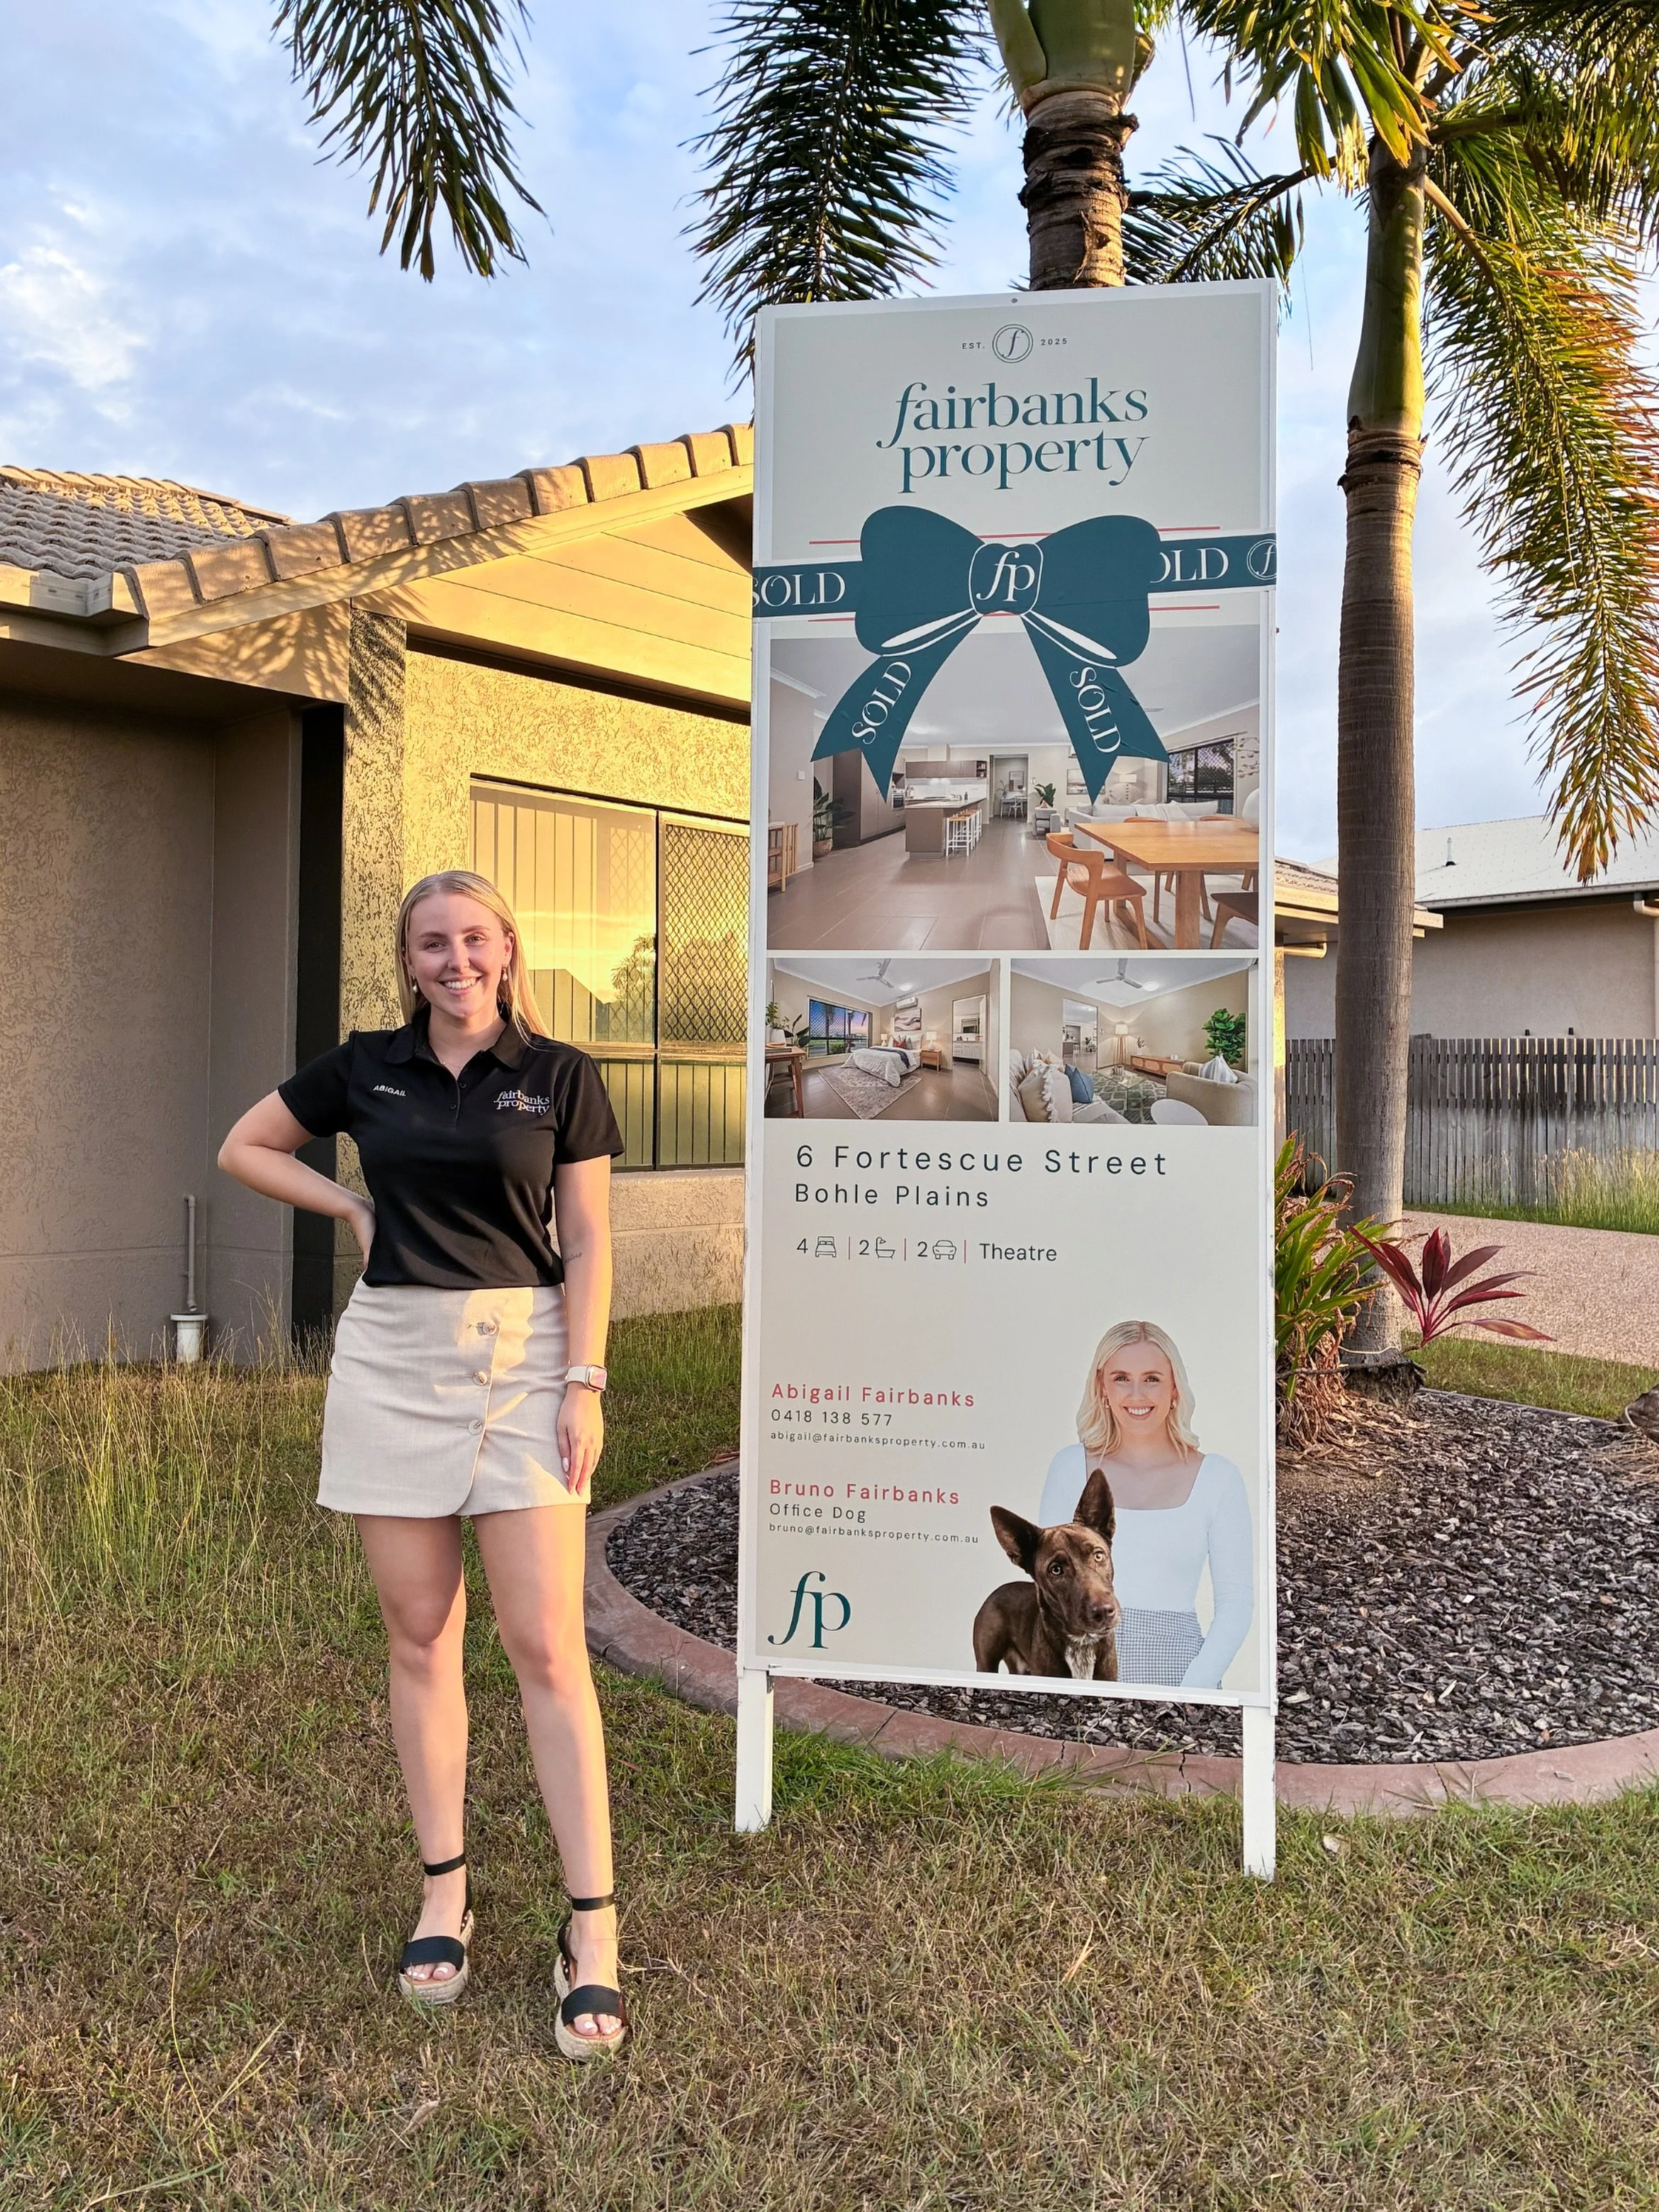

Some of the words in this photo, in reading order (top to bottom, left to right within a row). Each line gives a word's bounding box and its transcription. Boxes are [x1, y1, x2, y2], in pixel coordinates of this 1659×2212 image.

[1040, 337, 1068, 346] 2025
[876, 377, 1149, 449] fairbanks
[898, 430, 1150, 494] property
[976, 551, 1035, 603] fp
[851, 661, 912, 745] SOLD
[1069, 666, 1122, 754] SOLD
[373, 1085, 406, 1096] ABIGAIL
[493, 1090, 549, 1105] fairbanks
[496, 1100, 549, 1115] property
[796, 1145, 812, 1167] 6
[835, 1146, 1023, 1172] Fortescue
[1044, 1149, 1167, 1175] Street
[795, 1183, 878, 1205] Bohle
[896, 1185, 988, 1207] Plains
[796, 1238, 809, 1253] 4
[859, 1240, 870, 1256] 2
[917, 1241, 928, 1258] 2
[979, 1243, 1057, 1262] Theatre
[771, 1384, 850, 1404] Abigail
[862, 1387, 975, 1407] Fairbanks
[771, 1409, 812, 1423] 0418
[822, 1411, 851, 1424] 138
[861, 1413, 892, 1426] 577
[771, 1430, 985, 1450] abigail@fairbanksproperty.com.au
[770, 1480, 834, 1498] Bruno
[847, 1483, 959, 1504] Fairbanks
[770, 1503, 823, 1519] Office
[833, 1506, 866, 1524] Dog
[769, 1523, 978, 1544] bruno@fairbanksproperty.com.au
[767, 1570, 851, 1649] fp
